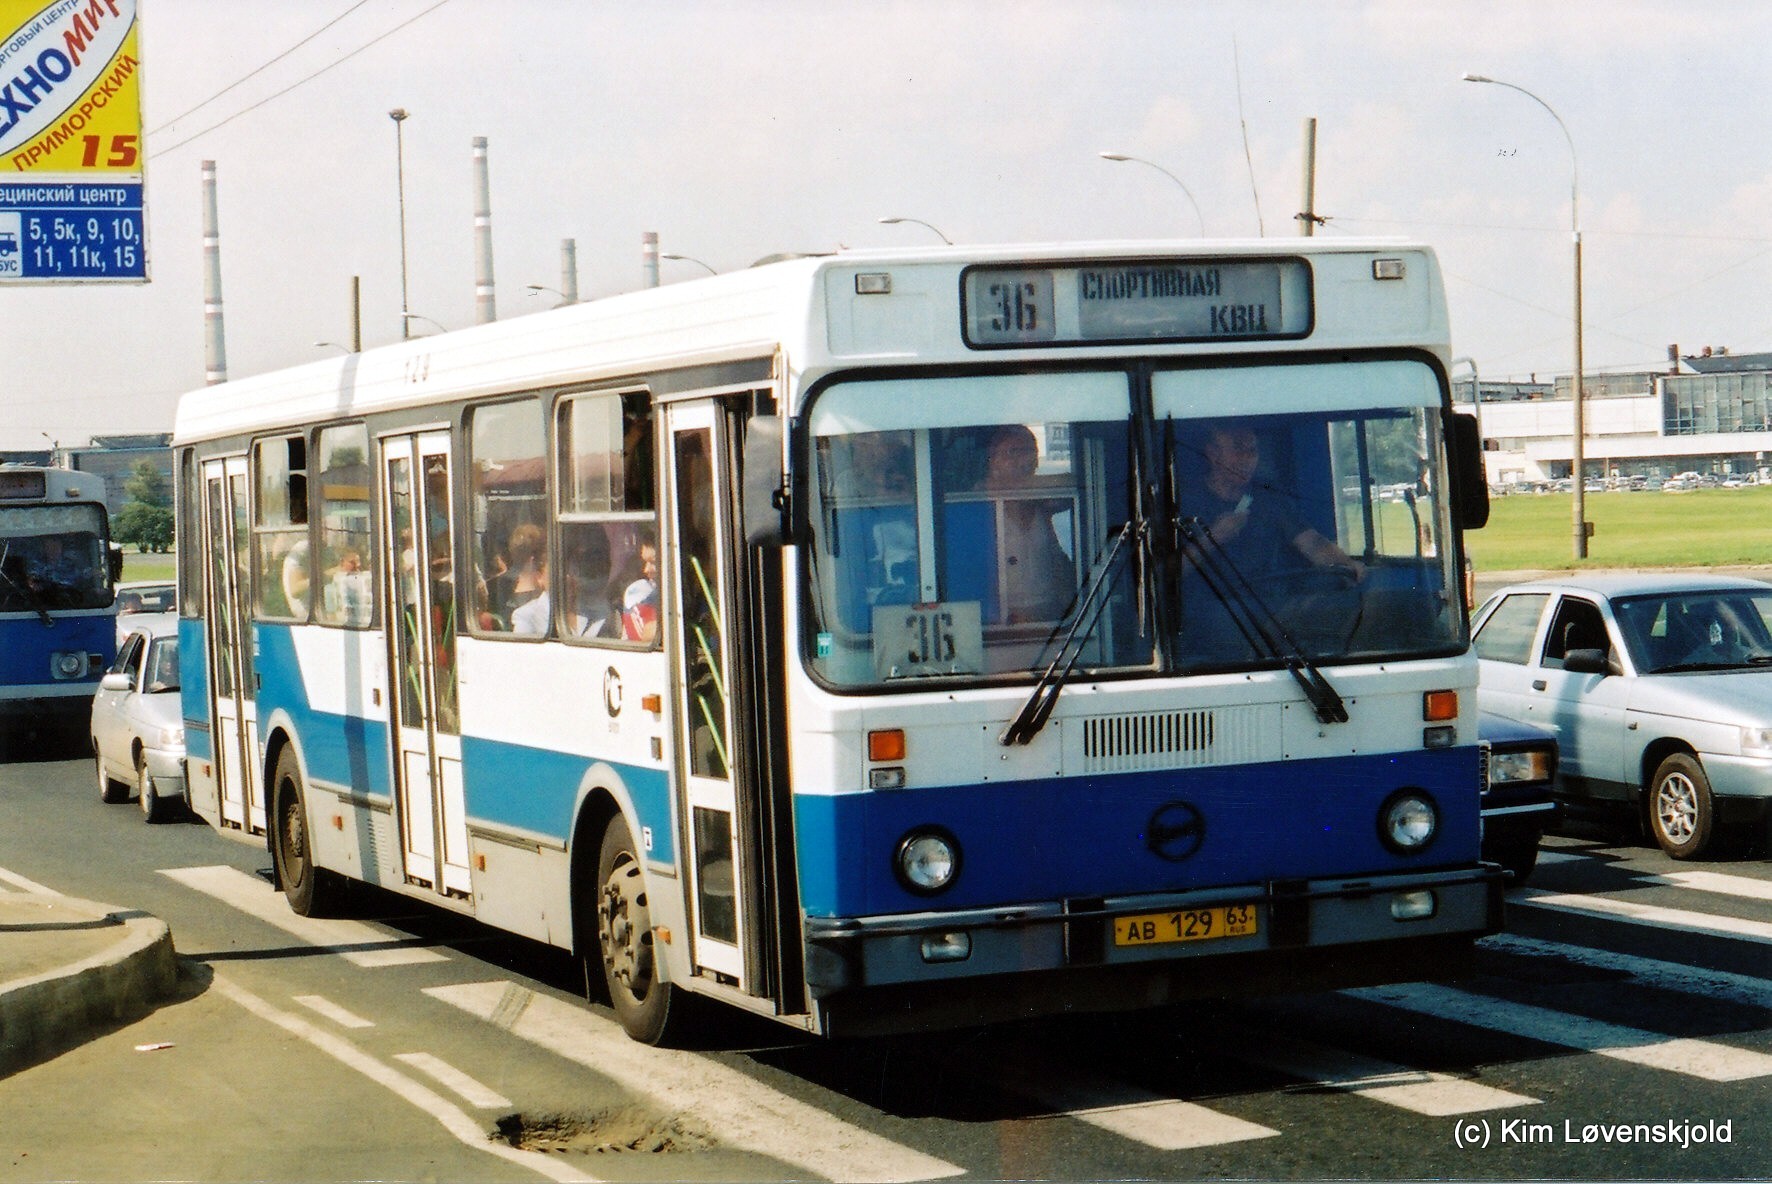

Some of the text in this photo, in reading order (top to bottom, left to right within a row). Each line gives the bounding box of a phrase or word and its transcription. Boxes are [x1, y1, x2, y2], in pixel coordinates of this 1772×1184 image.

[0, 22, 44, 68] РГОВЫЙ
[13, 54, 138, 171] ПРИМОРСКИЙ
[82, 135, 138, 167] 15
[80, 187, 126, 205] центр
[30, 218, 139, 244] 5, 5к, 9, 10,
[34, 246, 135, 272] 11, 11к, 15
[1082, 268, 1221, 299] СПОРТИВНАЯ
[990, 283, 1036, 331] 36
[1210, 304, 1268, 333] КВЦ
[906, 614, 956, 663] 36
[1170, 911, 1213, 937] 129
[1226, 905, 1248, 925] 63
